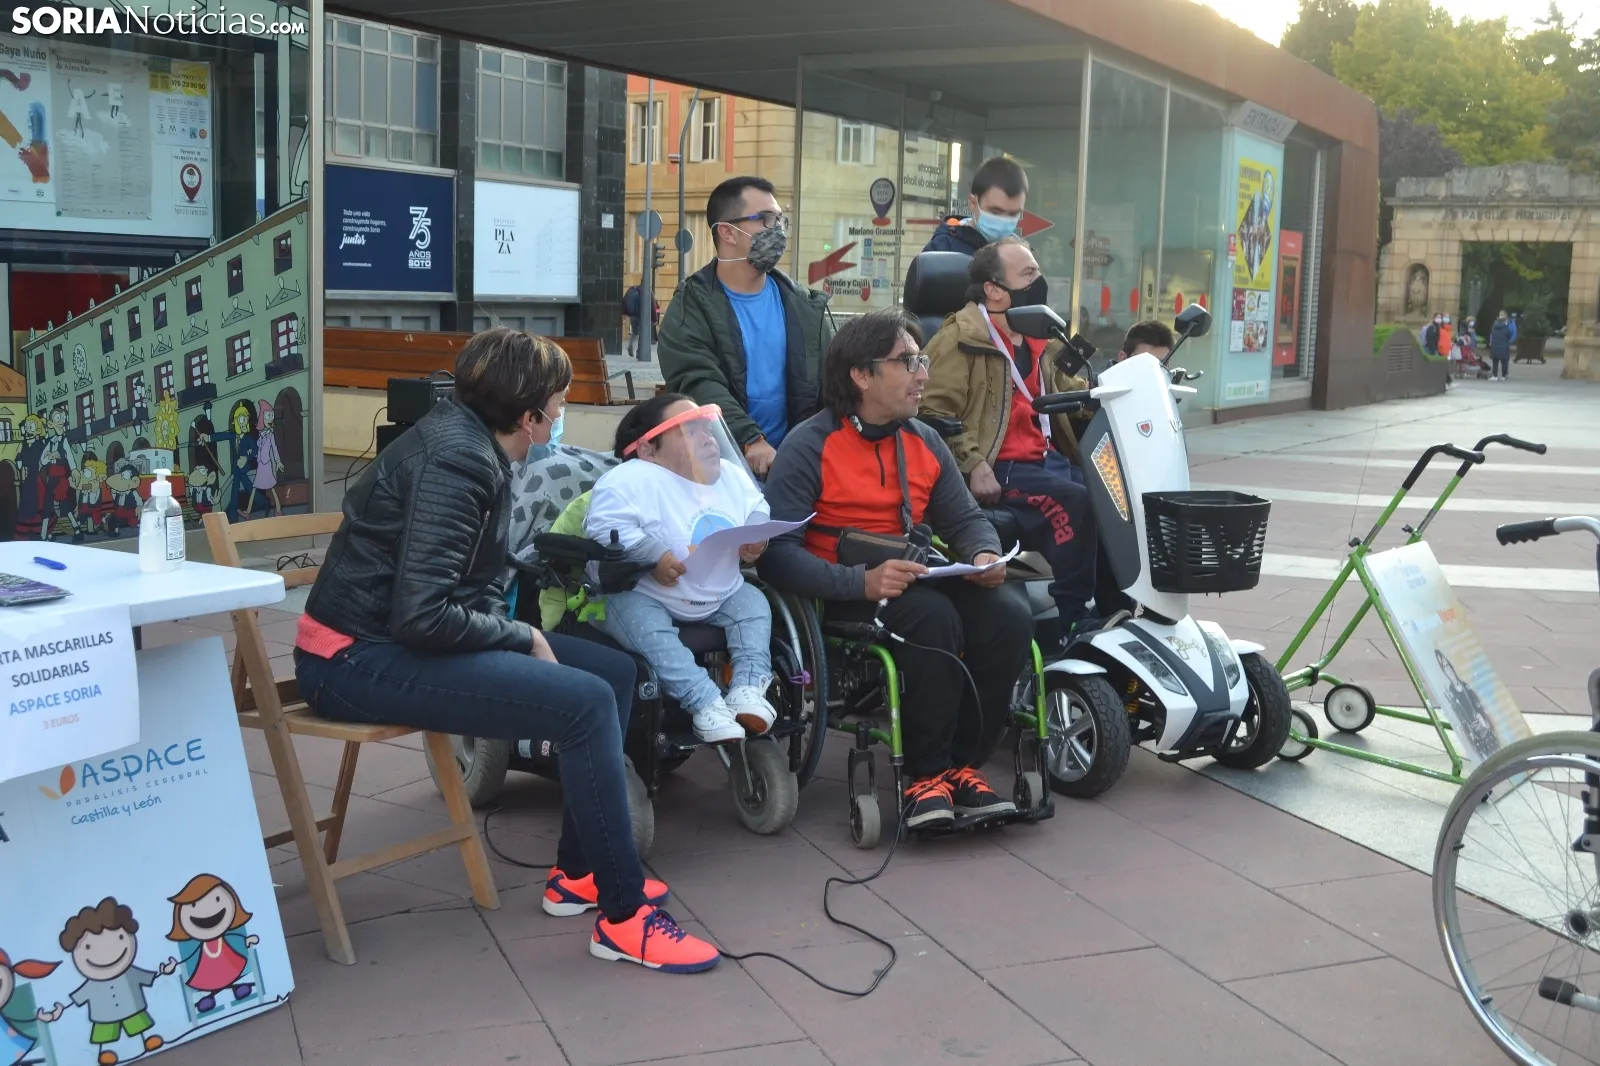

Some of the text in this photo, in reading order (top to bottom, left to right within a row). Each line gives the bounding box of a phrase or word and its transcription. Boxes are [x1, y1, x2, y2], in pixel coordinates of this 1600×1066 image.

[23, 46, 47, 60] Nuño
[408, 206, 432, 250] 75
[494, 228, 515, 242] PLA
[848, 226, 905, 236] Mariano Granados
[339, 233, 366, 250] juntos
[497, 241, 511, 254] ZA
[408, 249, 432, 259] AÑOS
[408, 259, 432, 268] SOTO
[825, 278, 846, 287] Ramón
[25, 631, 114, 660] MASCARILLAS
[11, 660, 90, 688] SOLIDARIAS
[9, 684, 102, 716] ASPACE SORIA
[43, 713, 80, 730] 3 EUROS
[81, 738, 206, 789] ASPACE
[146, 768, 209, 788] CEREBRAL
[71, 795, 162, 825] Castilla y León
